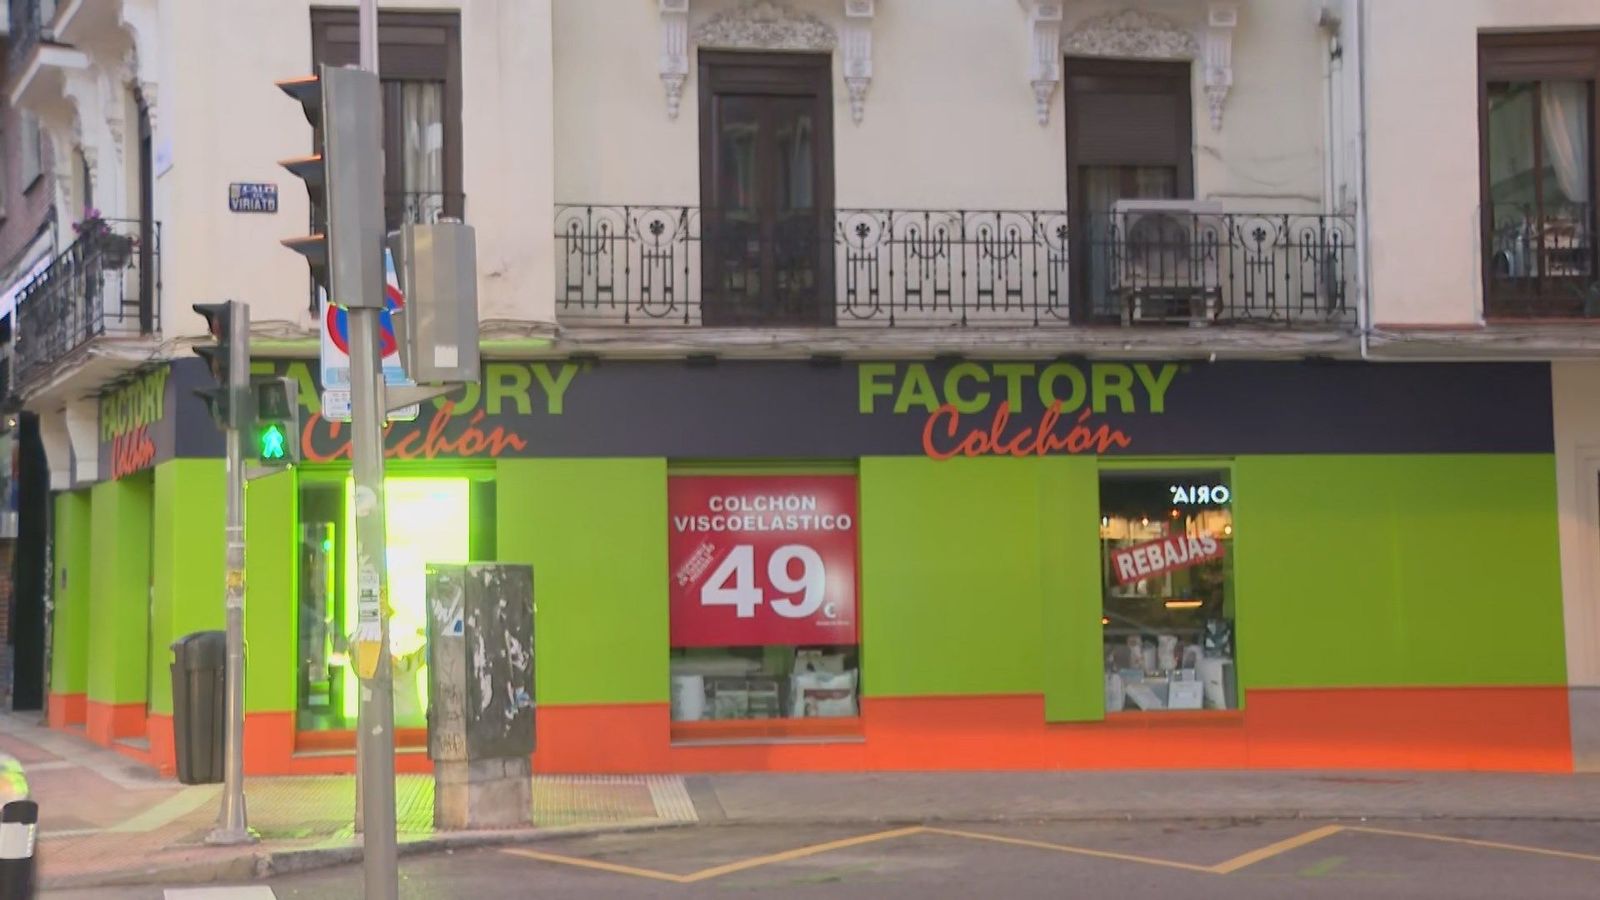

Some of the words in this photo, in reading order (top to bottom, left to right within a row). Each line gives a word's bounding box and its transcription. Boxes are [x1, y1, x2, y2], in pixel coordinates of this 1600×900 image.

[231, 198, 276, 211] VIRIATO
[102, 365, 170, 441] FACTORY
[858, 363, 1178, 414] FACTORY
[302, 400, 527, 464] Cchón
[922, 400, 1132, 461] Colchón
[701, 544, 827, 619] 49
[1117, 531, 1218, 580] REBAJAS
